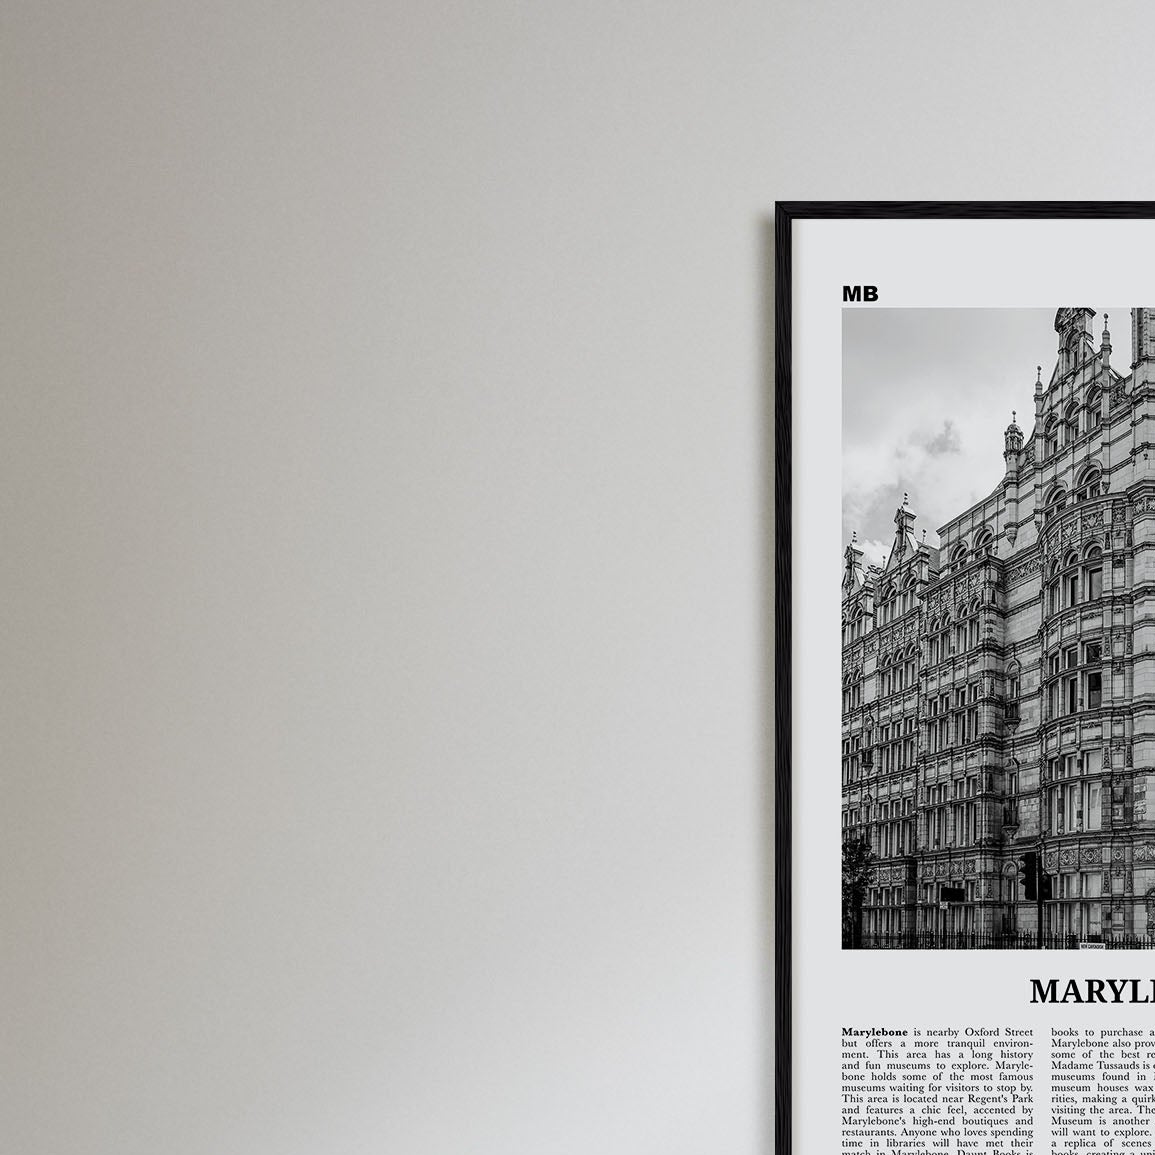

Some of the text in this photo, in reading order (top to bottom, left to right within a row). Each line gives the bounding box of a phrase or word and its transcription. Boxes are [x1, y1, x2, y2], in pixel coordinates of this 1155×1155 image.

[843, 286, 878, 302] MB
[842, 1027, 1033, 1039] Marylebone is nearby Oxford Street
[1052, 1038, 1109, 1050] Marylebone
[1113, 1038, 1131, 1048] also
[842, 1050, 868, 1059] ment.
[877, 1050, 898, 1059] This
[935, 1050, 951, 1059] has
[972, 1050, 993, 1061] long
[1001, 1050, 1033, 1061] history
[842, 1072, 865, 1081] bone
[871, 1072, 896, 1081] holds
[933, 1072, 943, 1081] of
[950, 1072, 964, 1081] the
[971, 1072, 993, 1081] most
[999, 1072, 1033, 1081] famous
[1102, 1072, 1129, 1081] found
[1137, 1072, 1146, 1081] in
[842, 1094, 863, 1103] This
[893, 1094, 899, 1103] is
[904, 1094, 938, 1103] located
[968, 1094, 1008, 1106] Regent's
[1012, 1094, 1033, 1103] Park
[1052, 1094, 1077, 1106] rities,
[1082, 1094, 1117, 1106] making
[1051, 1105, 1085, 1117] visiting
[1090, 1105, 1104, 1114] the
[1137, 1105, 1155, 1114] The
[842, 1116, 1033, 1128] Marylebone's high-end boutiques and
[1052, 1116, 1092, 1126] Museum
[1099, 1116, 1106, 1126] is
[1113, 1116, 1150, 1126] another
[842, 1127, 1033, 1139] restaurants. Anyone who loves spending
[1051, 1127, 1068, 1137] will
[1073, 1127, 1095, 1137] want
[1101, 1127, 1110, 1137] to
[1114, 1127, 1152, 1139] explore.
[842, 1138, 1033, 1148] time in libraries will have met their
[1064, 1138, 1096, 1150] replica
[1104, 1138, 1114, 1148] of
